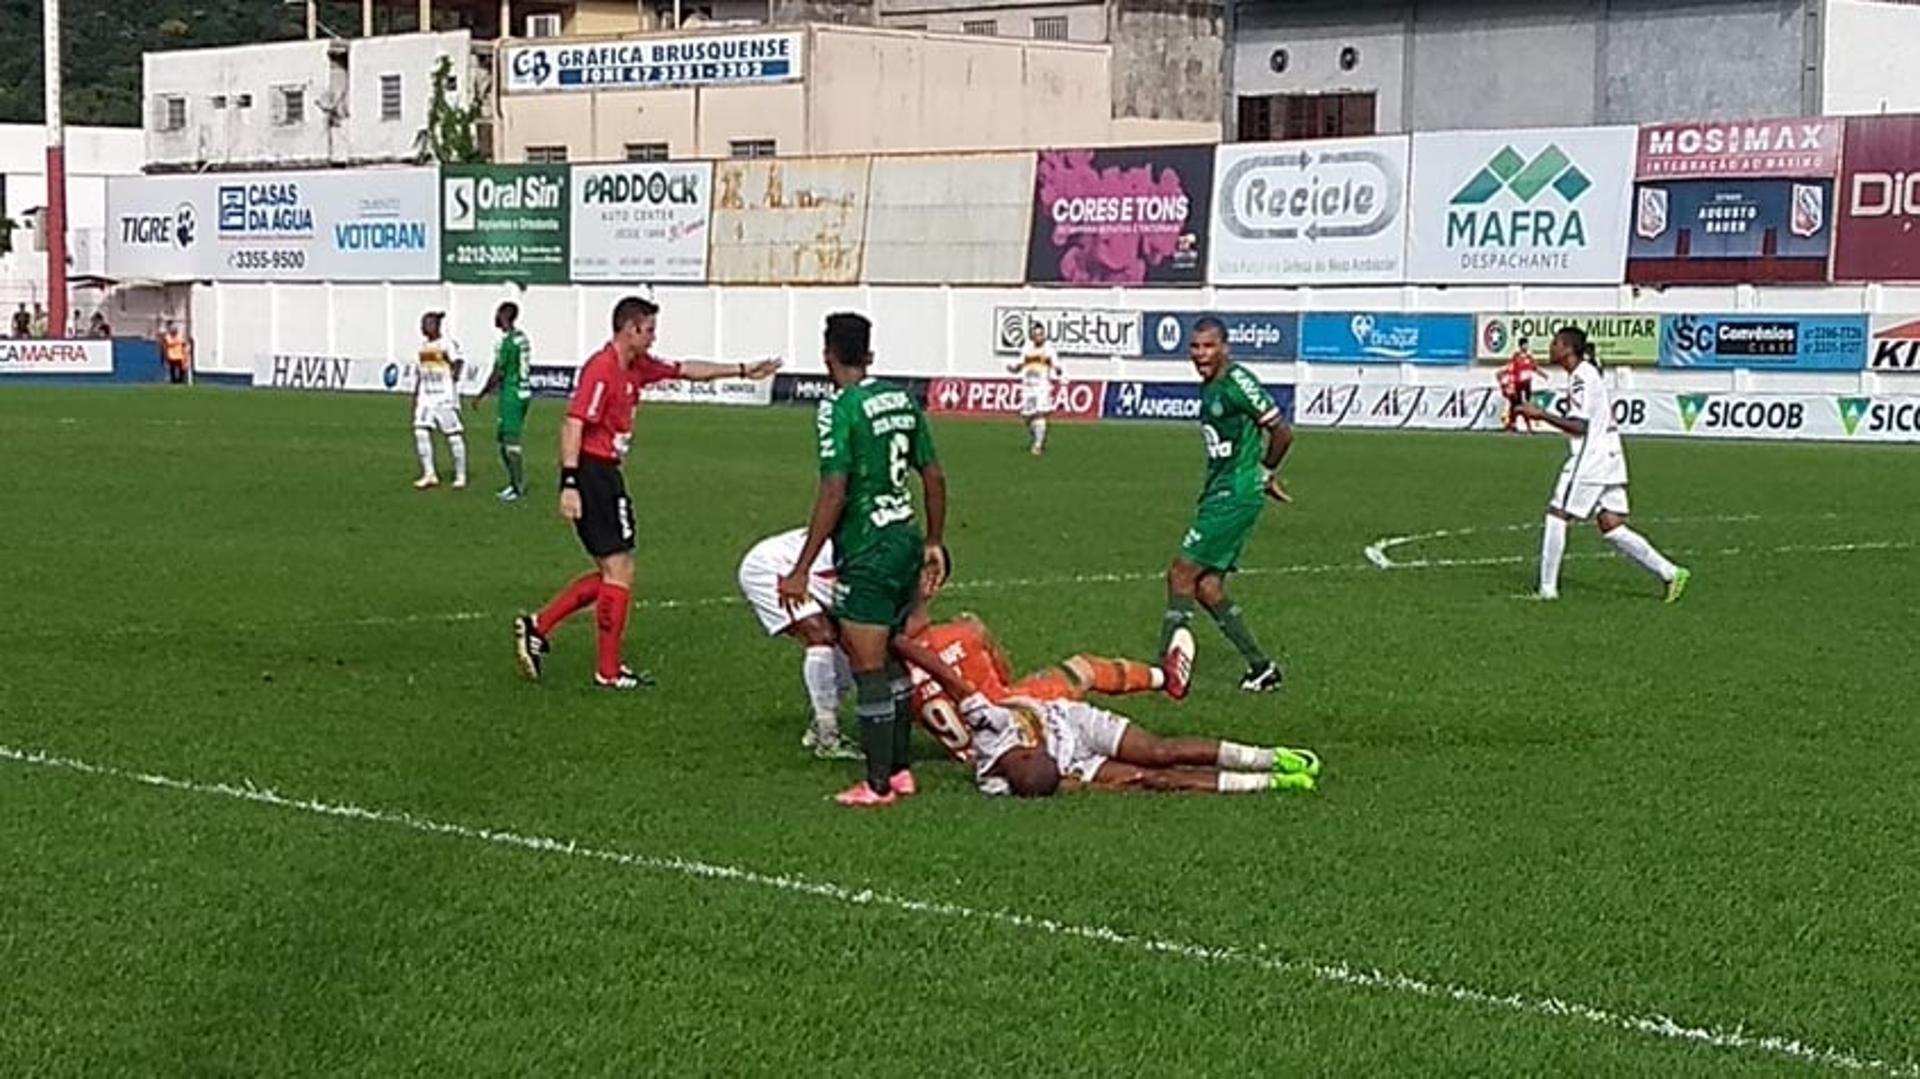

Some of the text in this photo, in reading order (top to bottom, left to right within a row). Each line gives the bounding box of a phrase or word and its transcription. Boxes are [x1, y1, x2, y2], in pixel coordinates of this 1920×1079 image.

[652, 39, 790, 62] BRUSQUENSE
[249, 183, 298, 206] CASAS
[478, 176, 559, 209] Oral Sin
[583, 171, 698, 204] PADDOCK
[1245, 175, 1375, 218] Recicle
[249, 208, 269, 231] DA
[1052, 194, 1190, 223] CORES E TONS
[122, 216, 171, 243] TIGRE
[335, 222, 426, 249] VOTORAN
[1446, 209, 1586, 247] MAFRA
[1460, 252, 1569, 269] DESPACHANTE
[1586, 318, 1656, 338] MILITAR
[272, 354, 350, 389] HAVAN
[1706, 401, 1804, 429] SICOOB
[922, 698, 970, 749] 9
